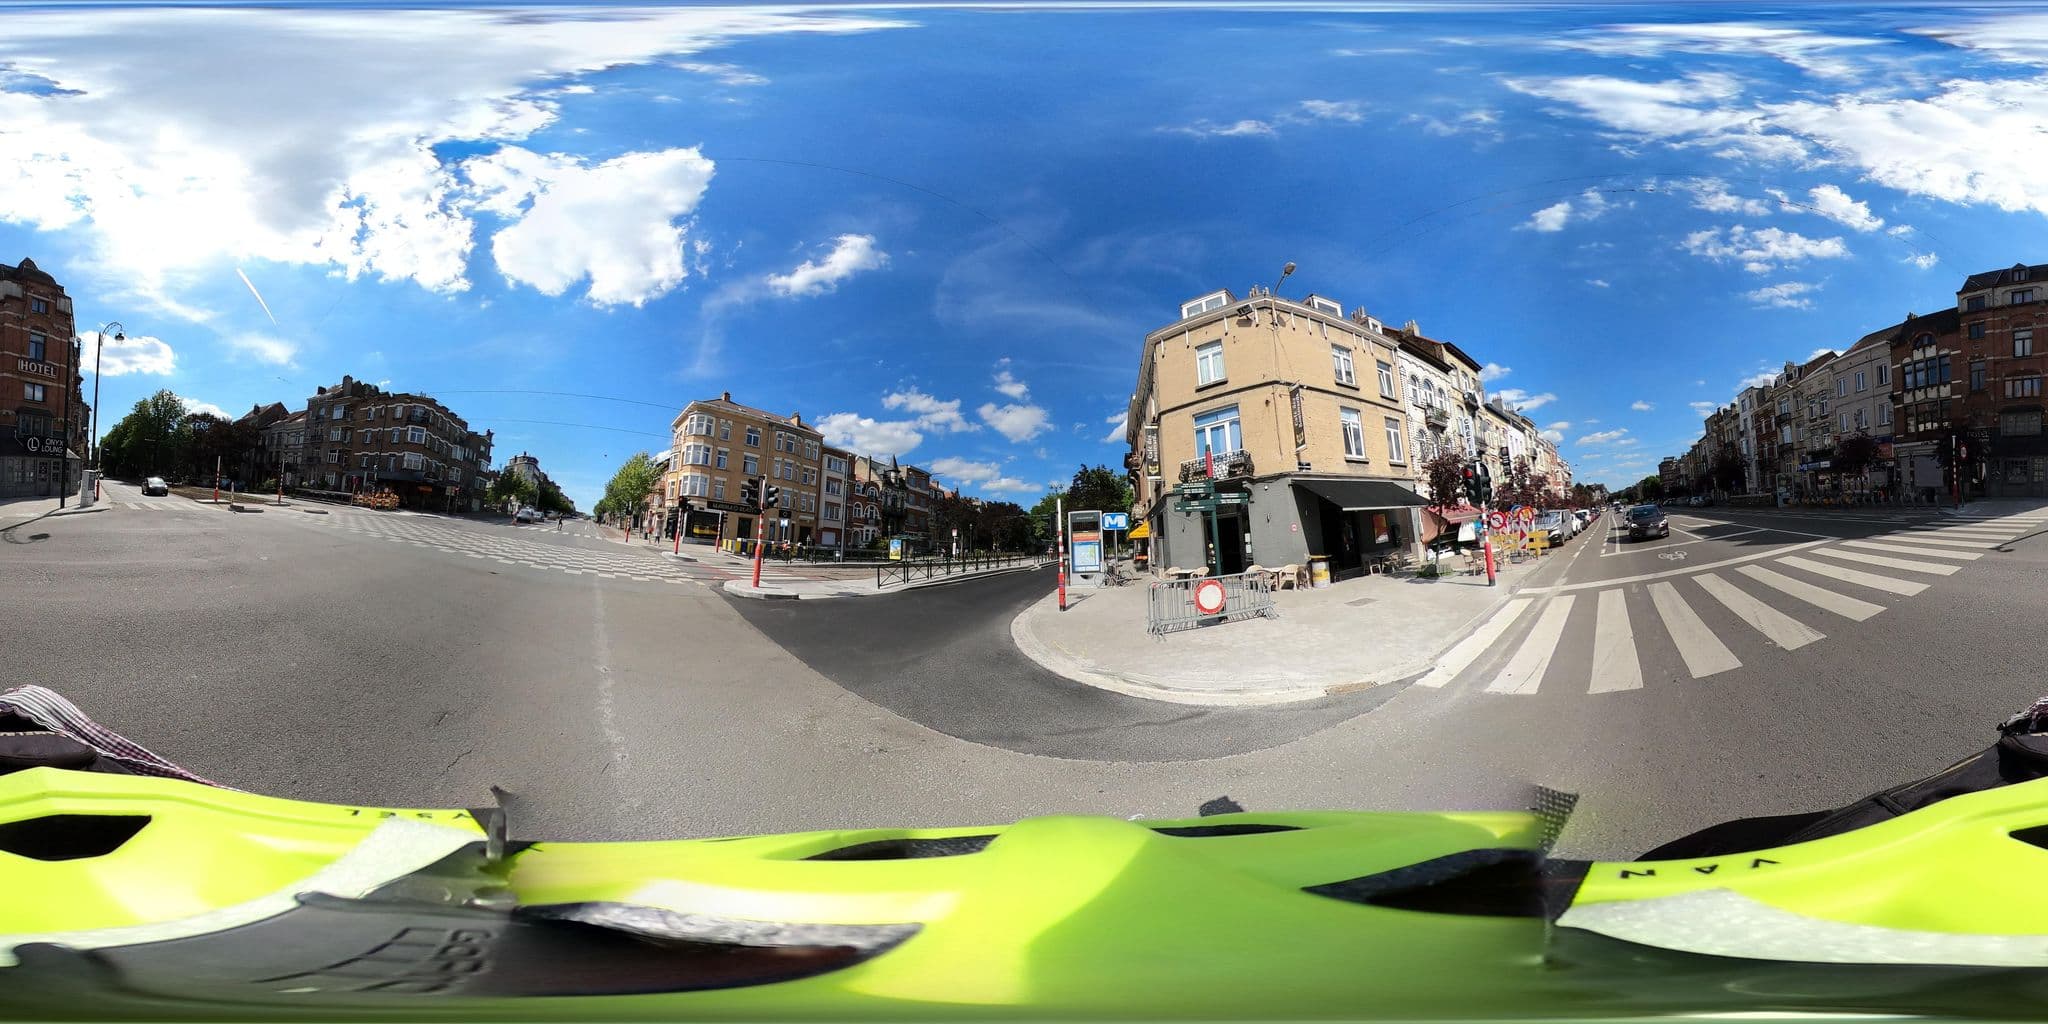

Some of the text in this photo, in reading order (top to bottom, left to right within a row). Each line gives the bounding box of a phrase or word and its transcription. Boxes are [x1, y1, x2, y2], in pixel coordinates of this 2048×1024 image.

[20, 360, 56, 376] HOTEL
[45, 438, 63, 446] ONYX
[41, 445, 63, 453] LOUNG
[1619, 857, 1781, 880] VAN
